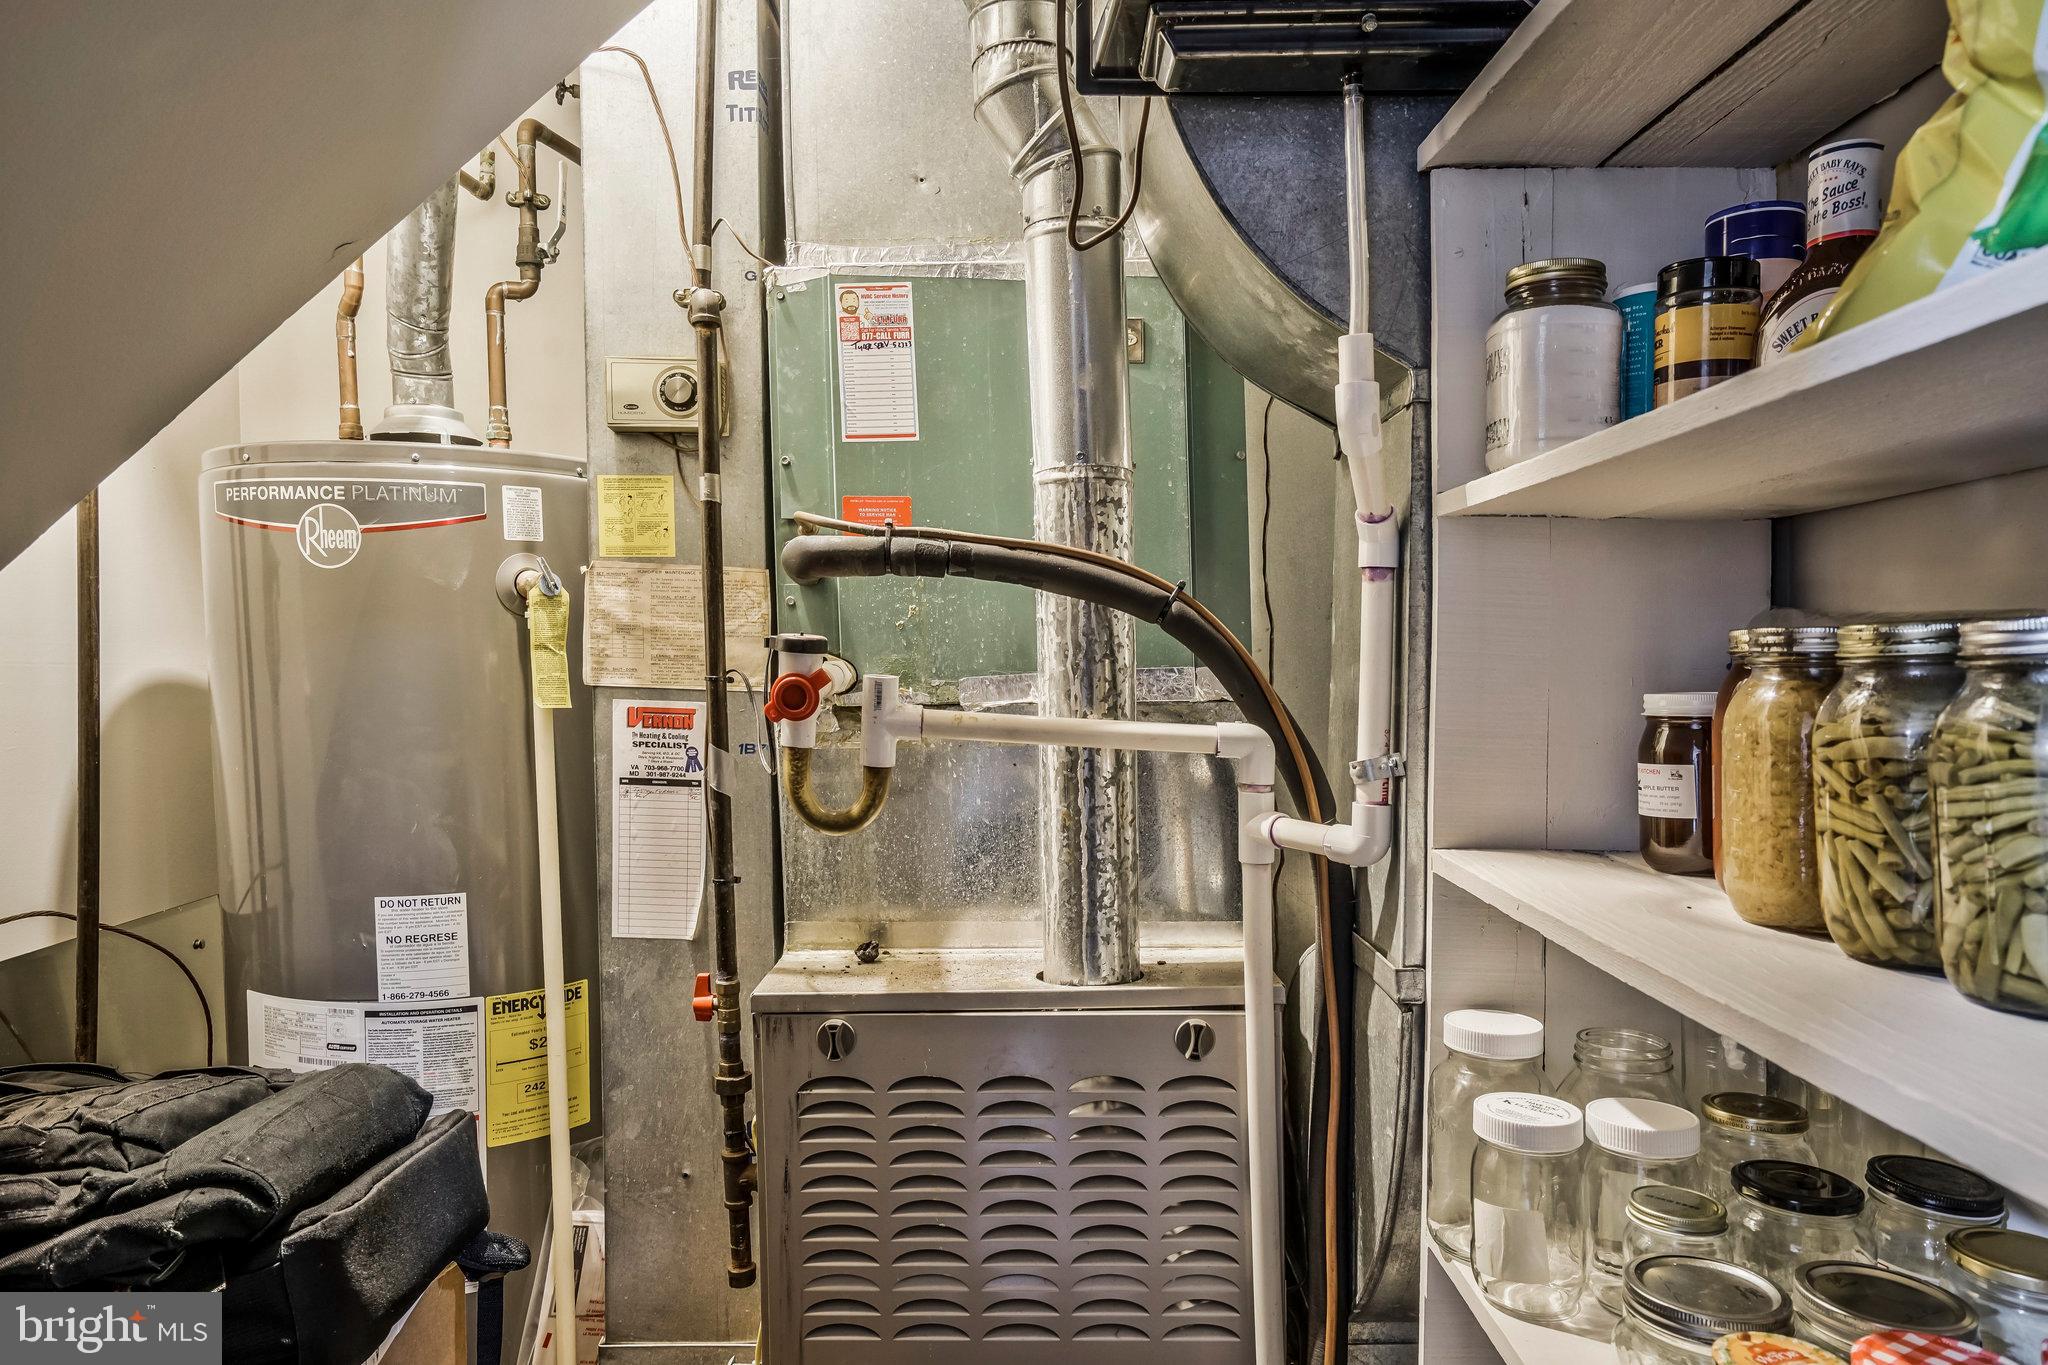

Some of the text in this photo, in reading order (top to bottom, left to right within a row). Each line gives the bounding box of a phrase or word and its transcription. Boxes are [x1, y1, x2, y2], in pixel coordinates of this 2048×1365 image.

[1820, 158, 1842, 172] BABY
[1822, 178, 1859, 202] Sauce
[1813, 209, 1828, 226] the
[1832, 191, 1867, 215] Boss!
[861, 331, 911, 340] 877-CALL FURR
[1771, 317, 1808, 353] SWEET
[225, 484, 457, 503] PERFORMANCE PLATINUM
[304, 506, 357, 558] Rheem
[627, 706, 697, 730] VERNON
[639, 732, 661, 740] Heating
[668, 733, 689, 741] Cooling
[632, 741, 689, 749] SPECIALIST
[380, 896, 461, 909] DO NOT RETURN
[386, 931, 458, 945] NO REGRESE
[382, 989, 450, 1001] 1-866-279-4566
[492, 994, 546, 1016] ENERGY
[524, 1081, 546, 1093] 242
